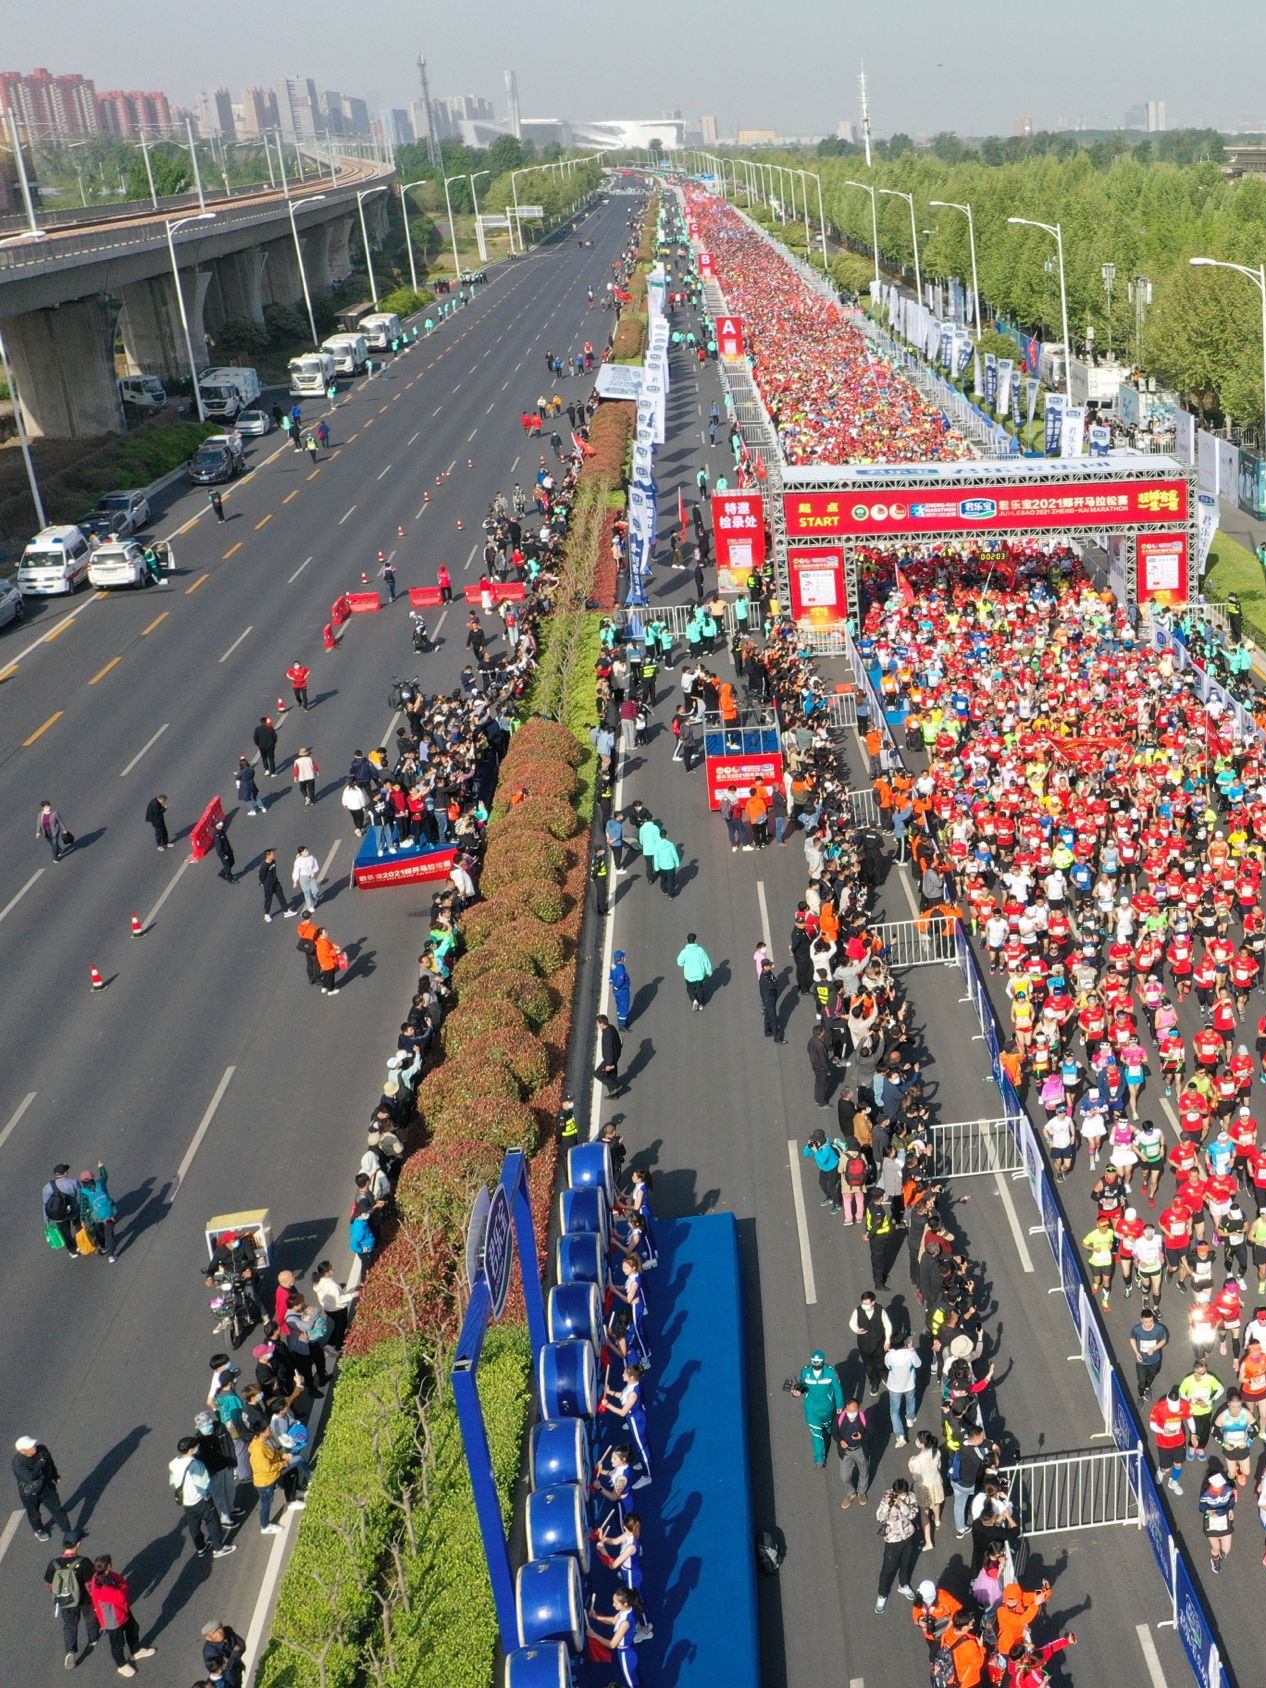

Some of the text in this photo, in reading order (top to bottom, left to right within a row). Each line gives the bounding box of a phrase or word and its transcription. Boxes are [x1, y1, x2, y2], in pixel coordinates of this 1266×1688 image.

[701, 255, 710, 264] B
[722, 320, 736, 334] A
[724, 502, 750, 514] 特邀
[965, 501, 993, 511] 君乐宝
[999, 495, 1129, 510] 君乐宝2021郑开马拉松赛
[1090, 505, 1129, 513] MARATHON
[719, 515, 757, 529] 检录处
[799, 516, 840, 527] START
[489, 1199, 507, 1280] 君乐宝
